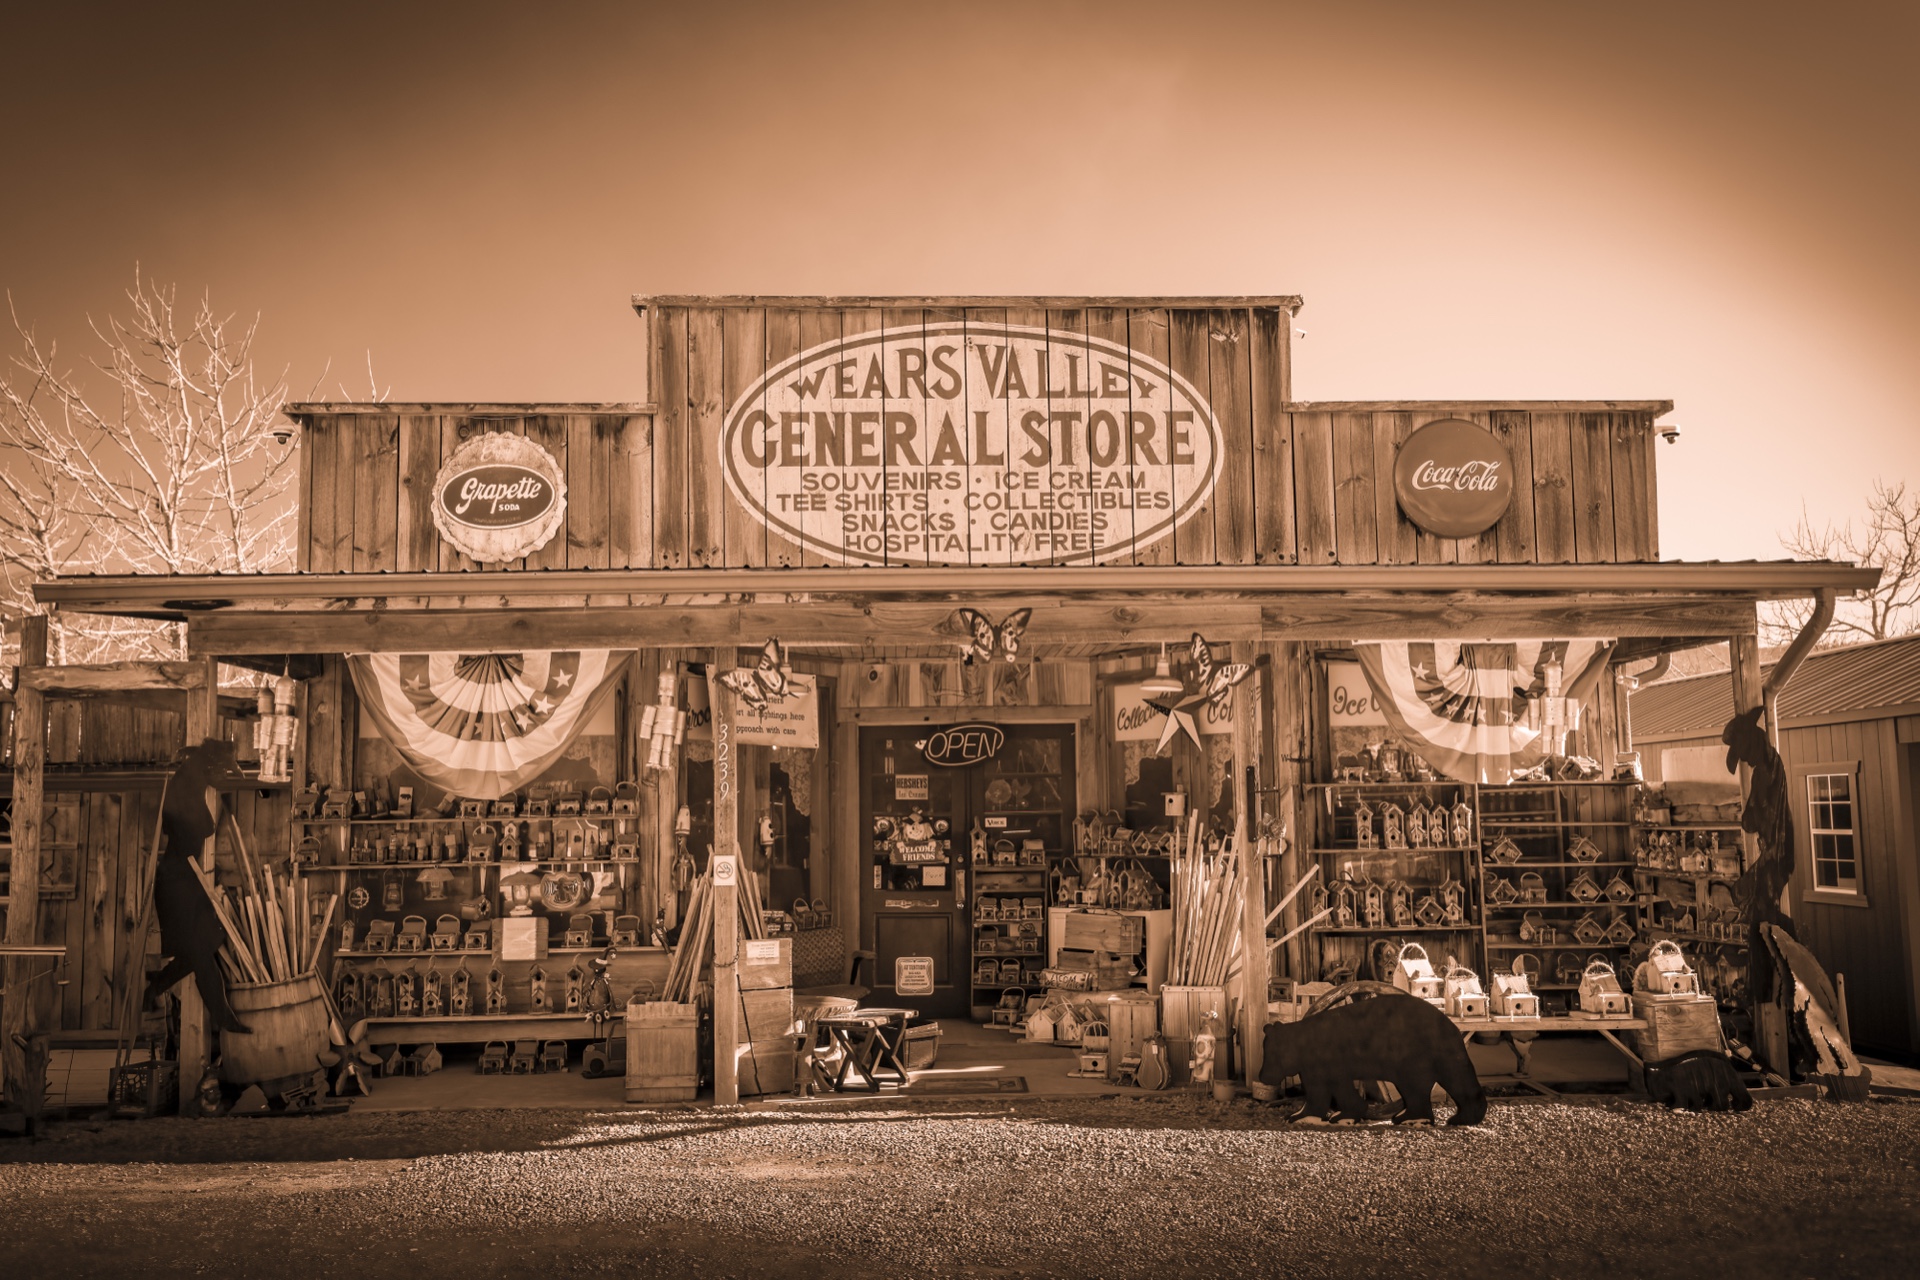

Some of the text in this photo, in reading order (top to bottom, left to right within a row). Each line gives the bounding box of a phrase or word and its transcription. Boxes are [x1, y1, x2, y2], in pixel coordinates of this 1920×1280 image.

[787, 343, 1158, 401] WEARS VALLEY
[741, 407, 1195, 469] GENERAL STORE
[802, 471, 1146, 491] SOUVENIRS ICE CREAM
[1411, 460, 1502, 492] Coca-Cola
[455, 476, 542, 515] Grapette
[776, 491, 1171, 512] TEE SHIRTS COLLECTIBLES
[498, 503, 520, 511] SODA
[842, 512, 1109, 532] SNACKS CANDIES
[845, 533, 1105, 553] HOSPITALITY FREE
[1332, 685, 1367, 716] Ice
[790, 712, 805, 721] here
[736, 725, 764, 734] pproach
[927, 732, 999, 758] OPEN
[899, 844, 936, 854] WELCOME
[903, 852, 936, 862] FRIENDS
